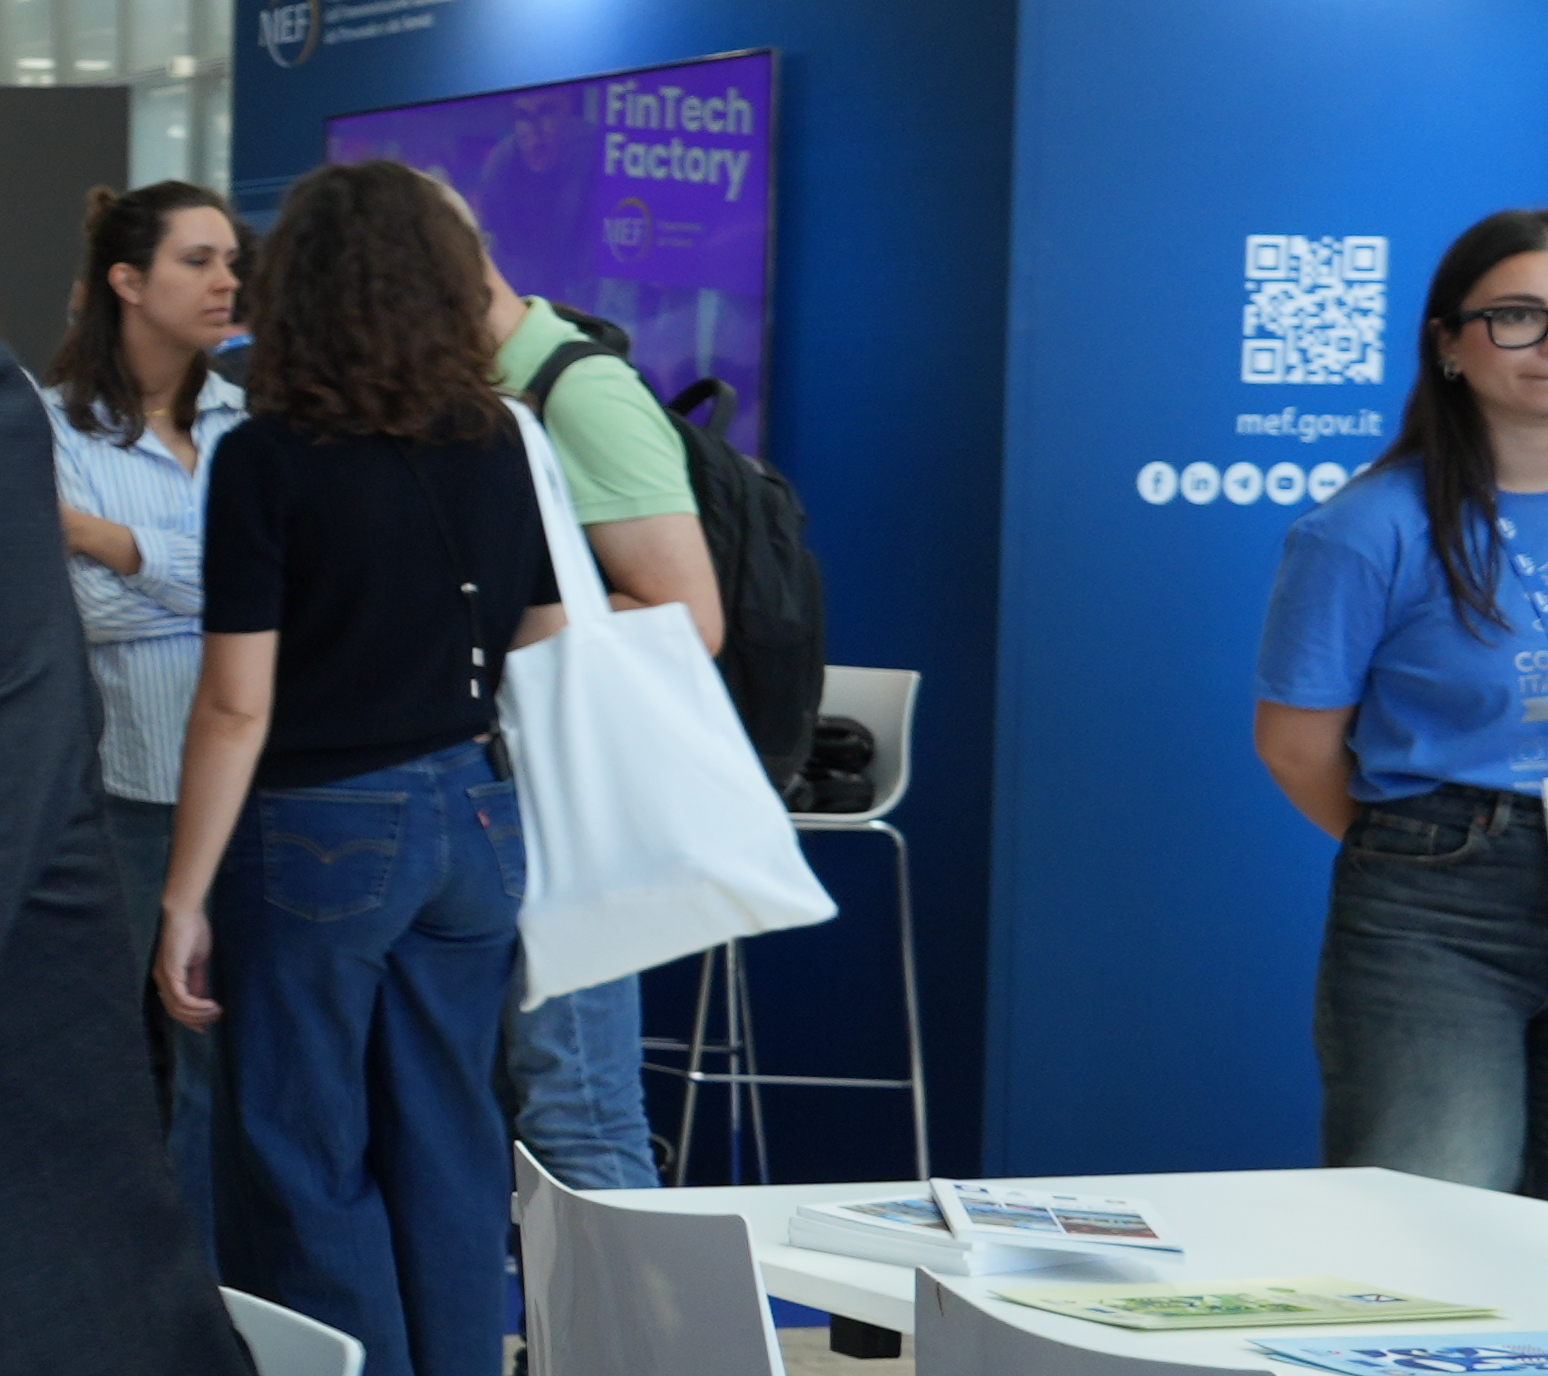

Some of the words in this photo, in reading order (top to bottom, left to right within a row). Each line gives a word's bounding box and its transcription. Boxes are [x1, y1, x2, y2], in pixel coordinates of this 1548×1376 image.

[258, 2, 313, 46] MEF
[606, 79, 753, 135] FinTech
[605, 132, 750, 202] Factory
[1236, 406, 1382, 443] mef.gov.it
